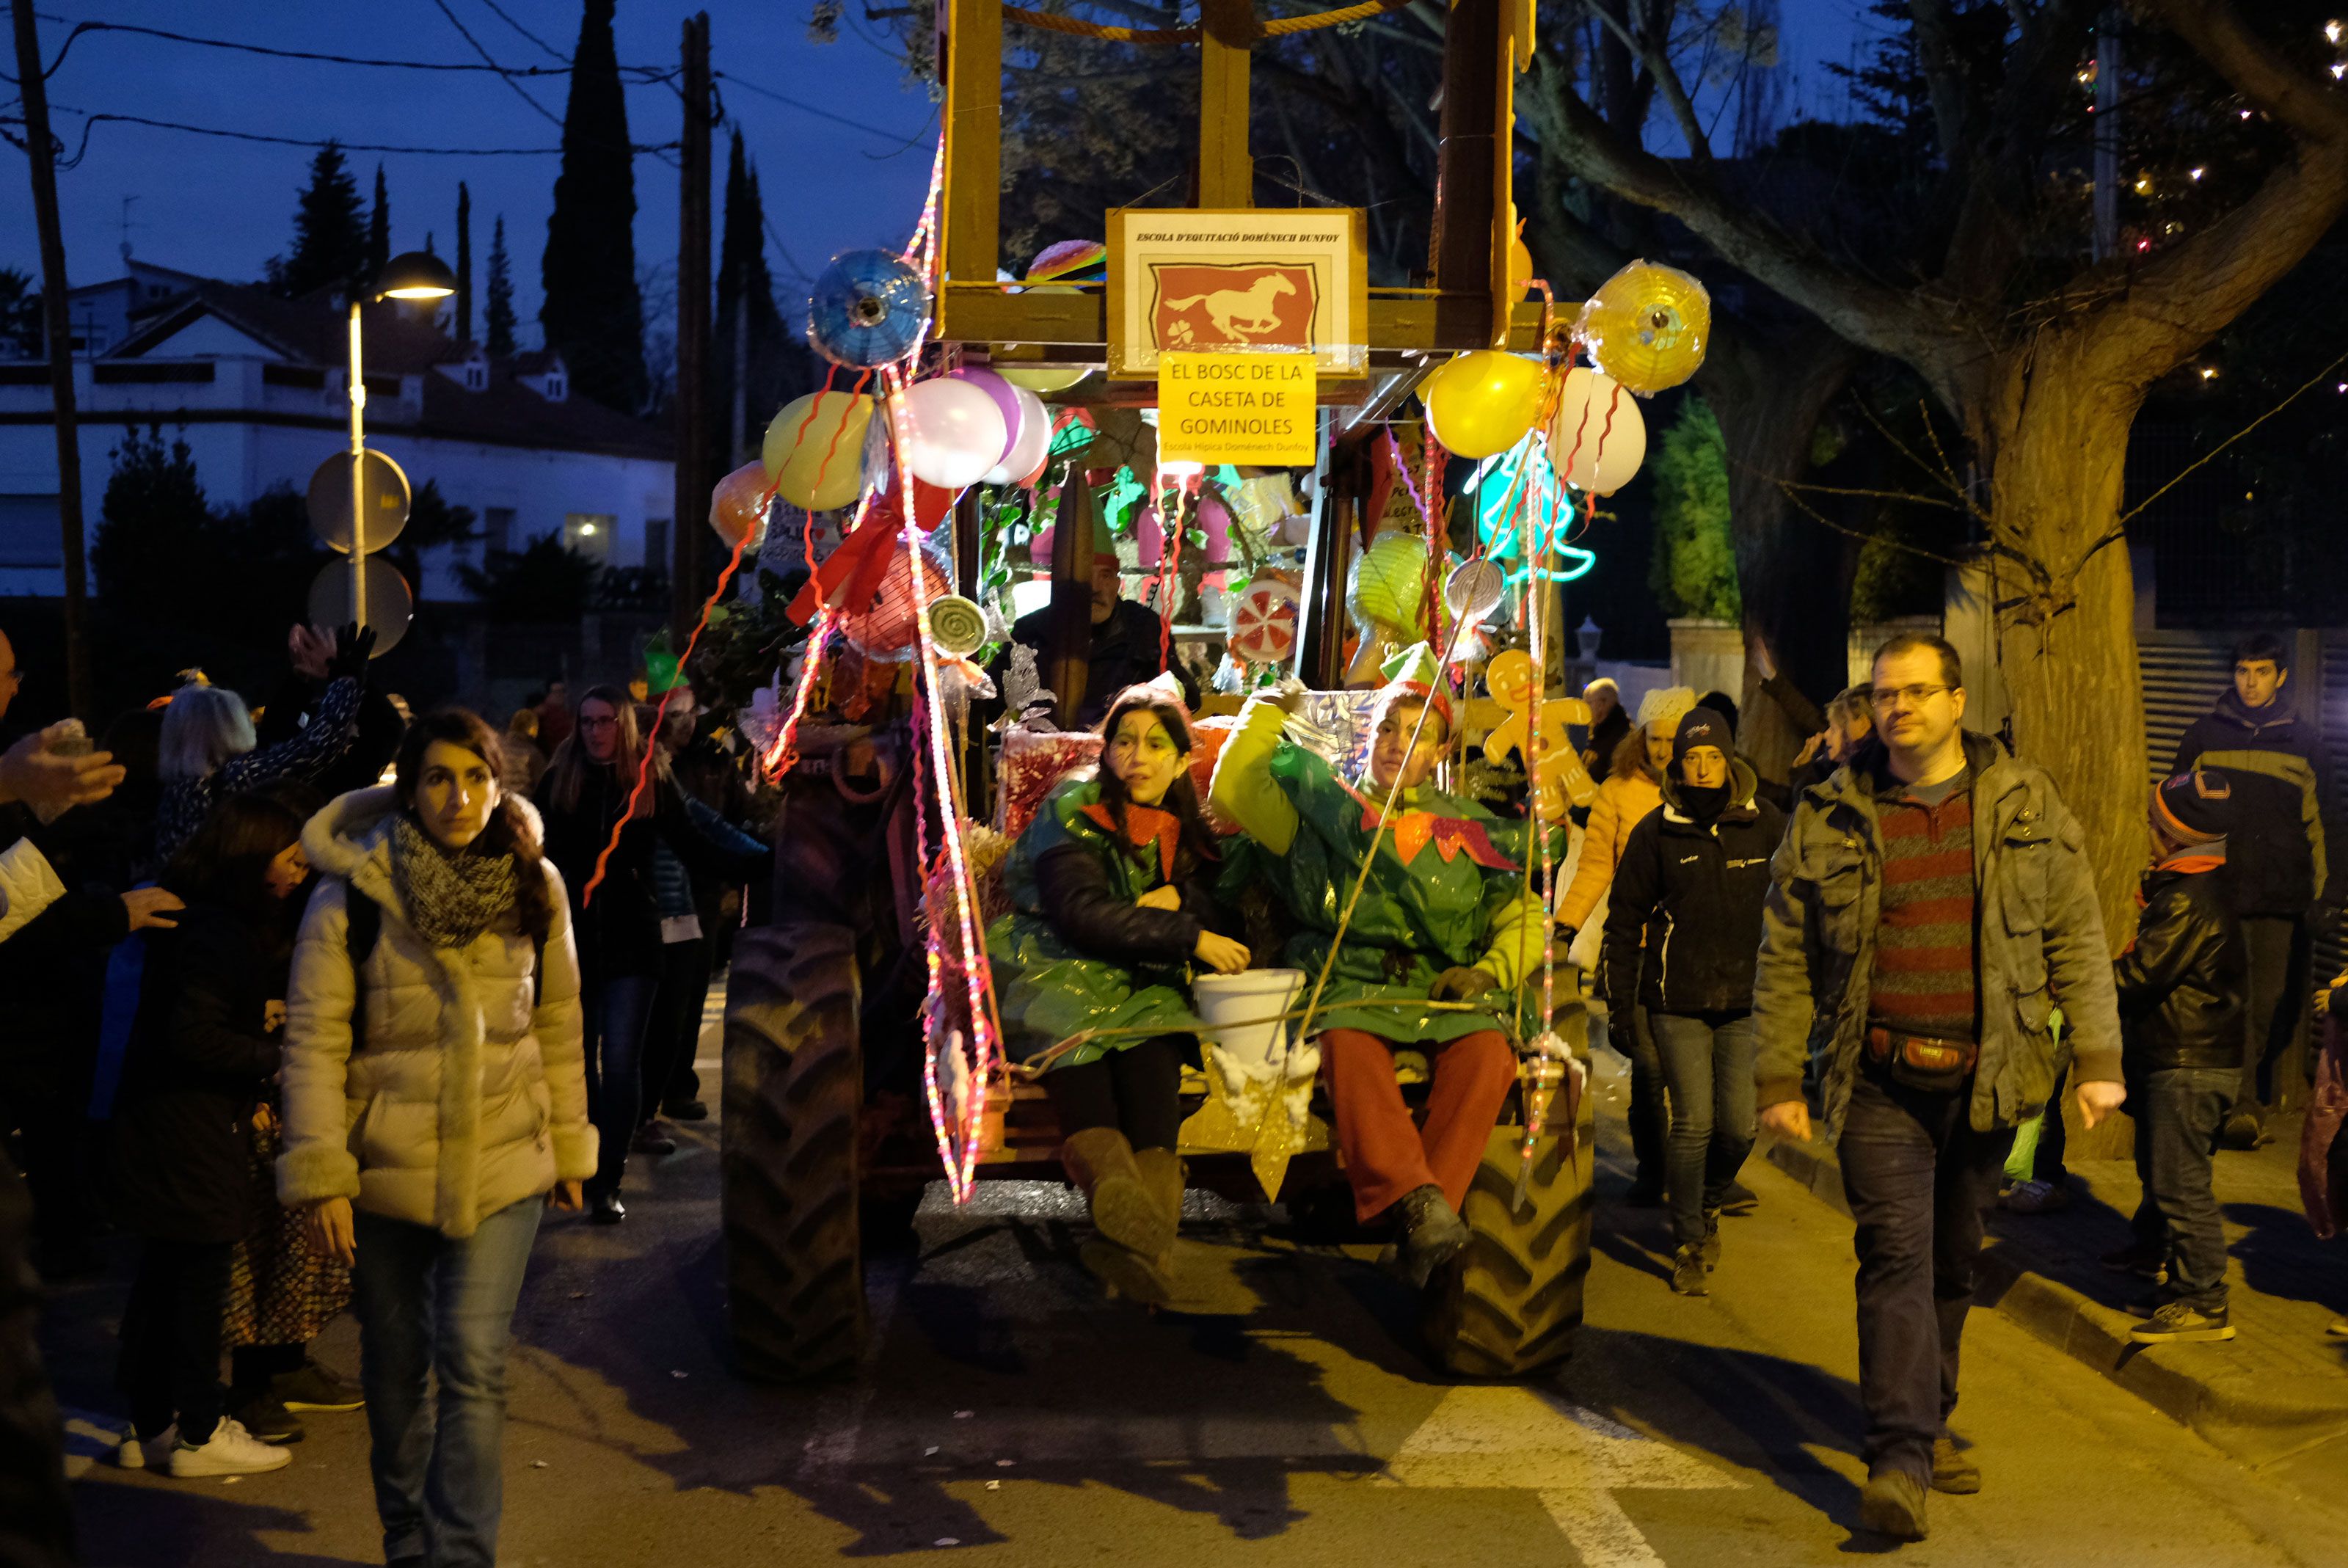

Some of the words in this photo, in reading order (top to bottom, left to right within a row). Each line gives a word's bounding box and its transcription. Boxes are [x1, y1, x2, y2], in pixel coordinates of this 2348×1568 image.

[1137, 233, 1173, 242] ESCOLA
[1175, 232, 1239, 243] D'EQUITACIÓ
[1298, 233, 1340, 243] DUNFOY
[1172, 364, 1191, 379] EL
[1197, 364, 1245, 380] BOSC
[1252, 365, 1274, 380] DE
[1281, 365, 1303, 380] LA
[1188, 391, 1256, 407] CASETA
[1262, 392, 1285, 407] DE
[1180, 418, 1293, 434] GOMINOLES
[1164, 442, 1192, 451] Escola
